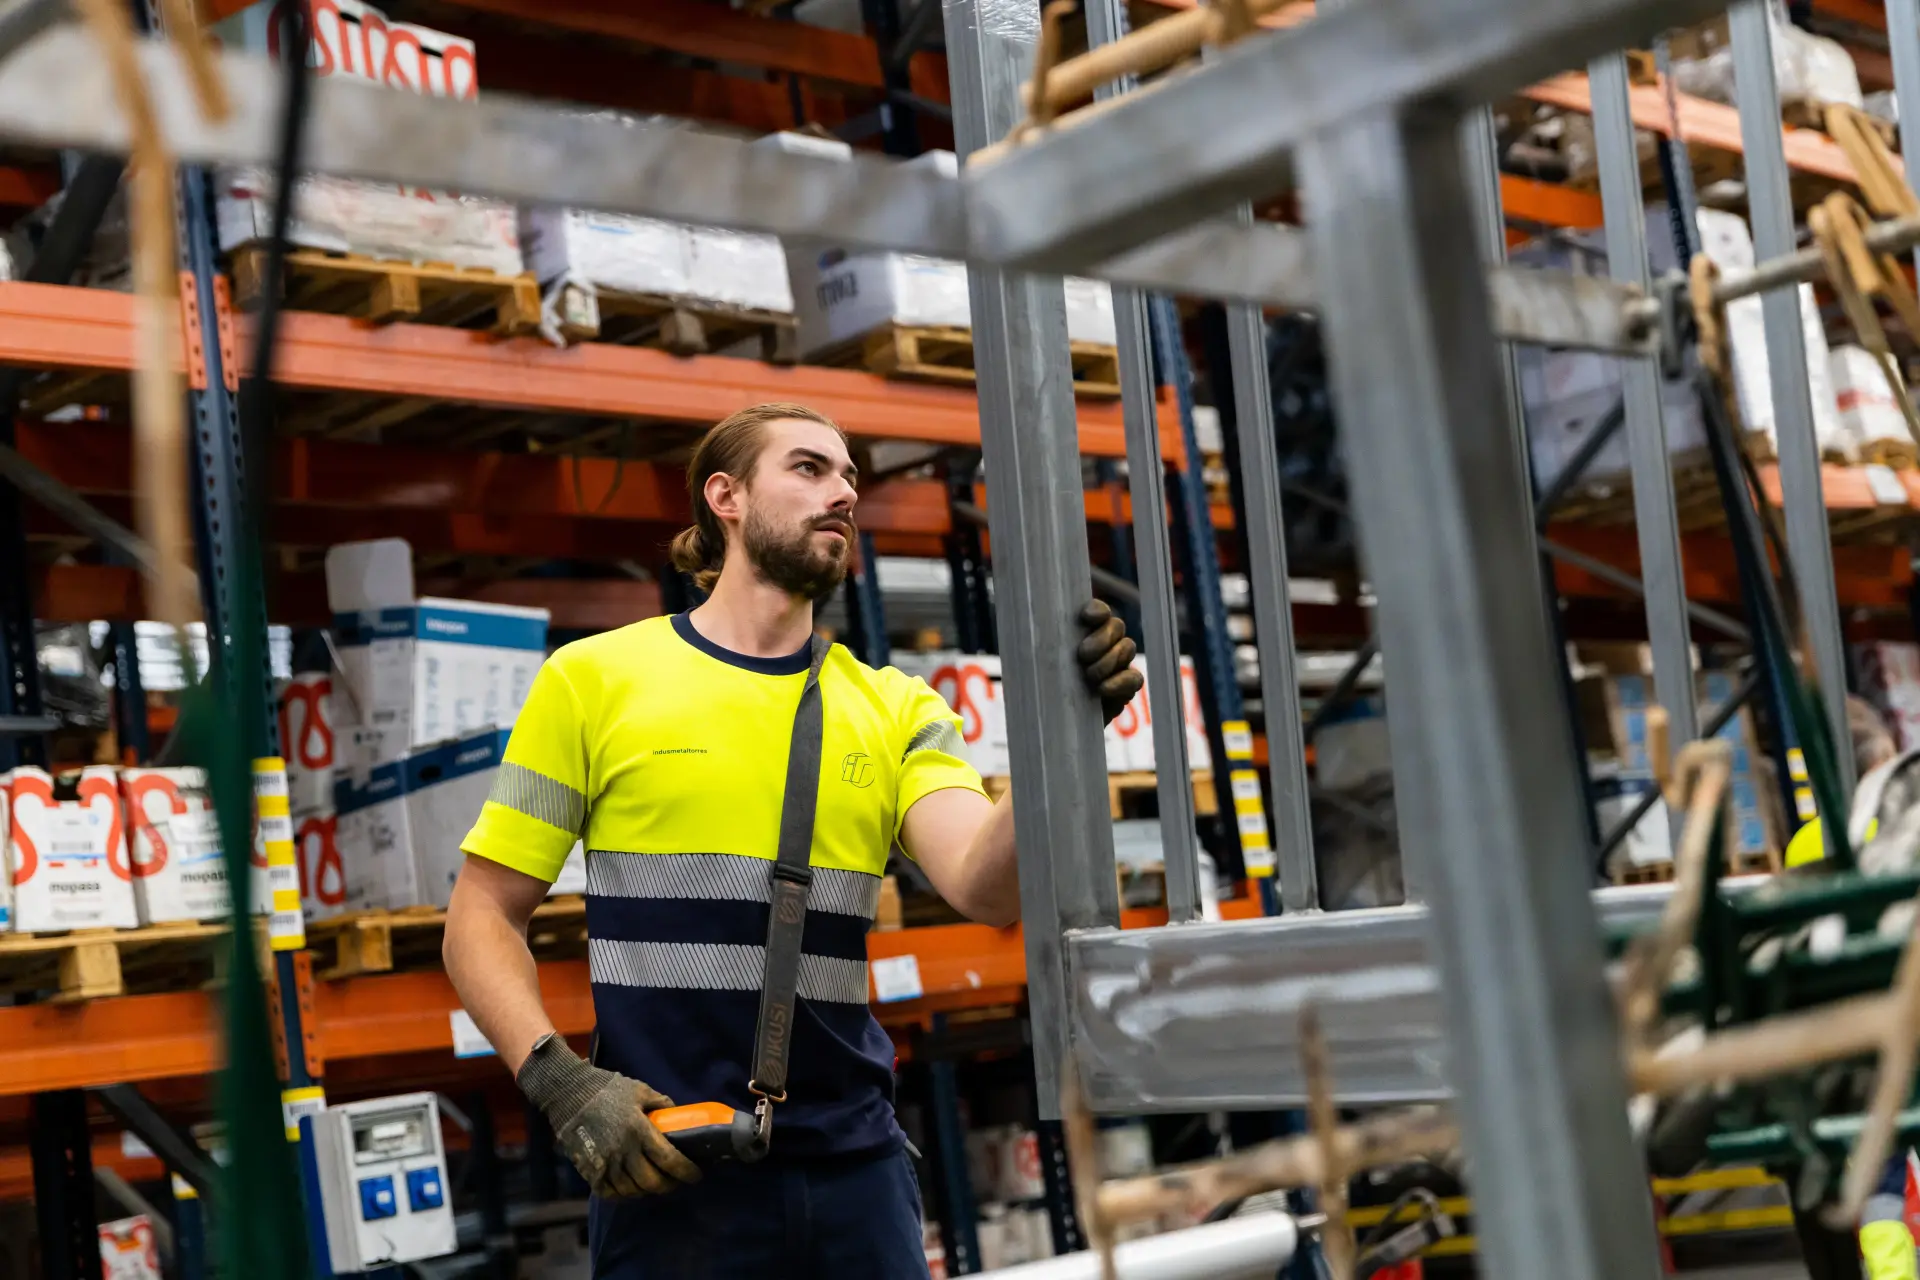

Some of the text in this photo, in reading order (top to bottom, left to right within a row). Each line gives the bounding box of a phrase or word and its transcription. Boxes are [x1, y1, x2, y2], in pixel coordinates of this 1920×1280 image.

[652, 747, 708, 756] indusmetaltorres
[49, 880, 101, 894] mopasa
[766, 1002, 787, 1057] IKUSI
